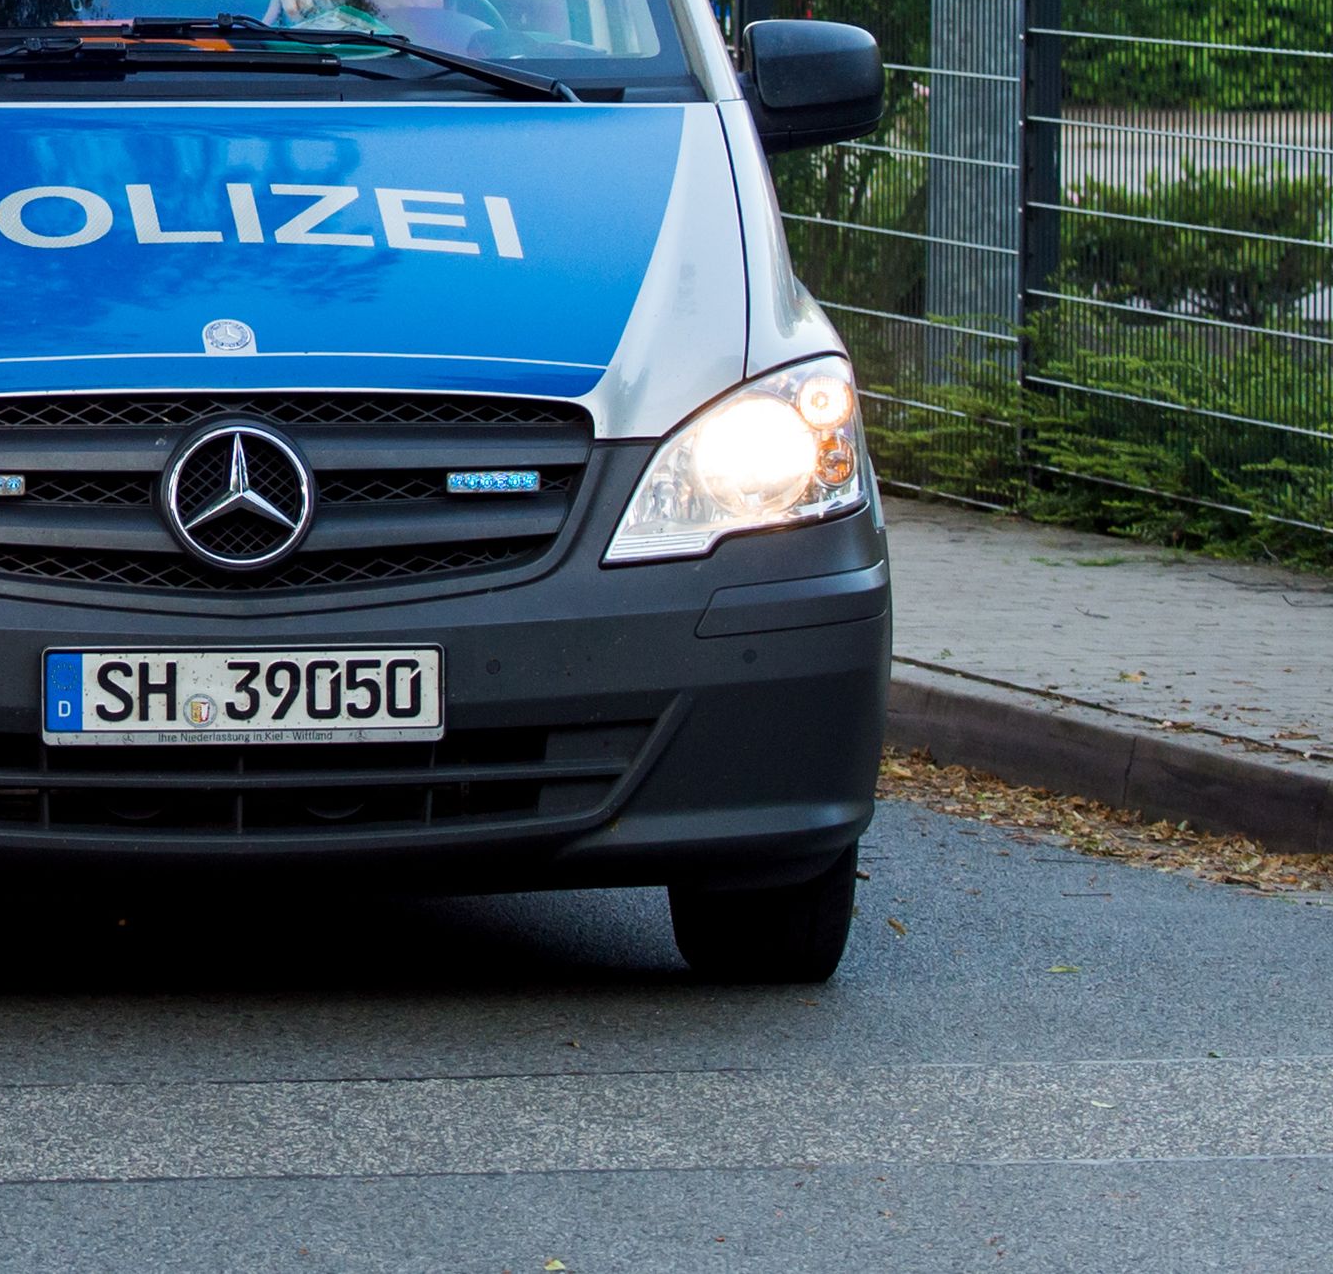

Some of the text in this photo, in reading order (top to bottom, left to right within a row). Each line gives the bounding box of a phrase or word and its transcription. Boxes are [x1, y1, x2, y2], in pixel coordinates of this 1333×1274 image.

[95, 658, 422, 722] SH 39050
[58, 700, 71, 717] D
[158, 733, 178, 743] Ihre
[180, 731, 251, 744] Niederlassung
[253, 731, 263, 742] in
[264, 730, 284, 742] Kiel
[292, 729, 334, 742] Wittland
